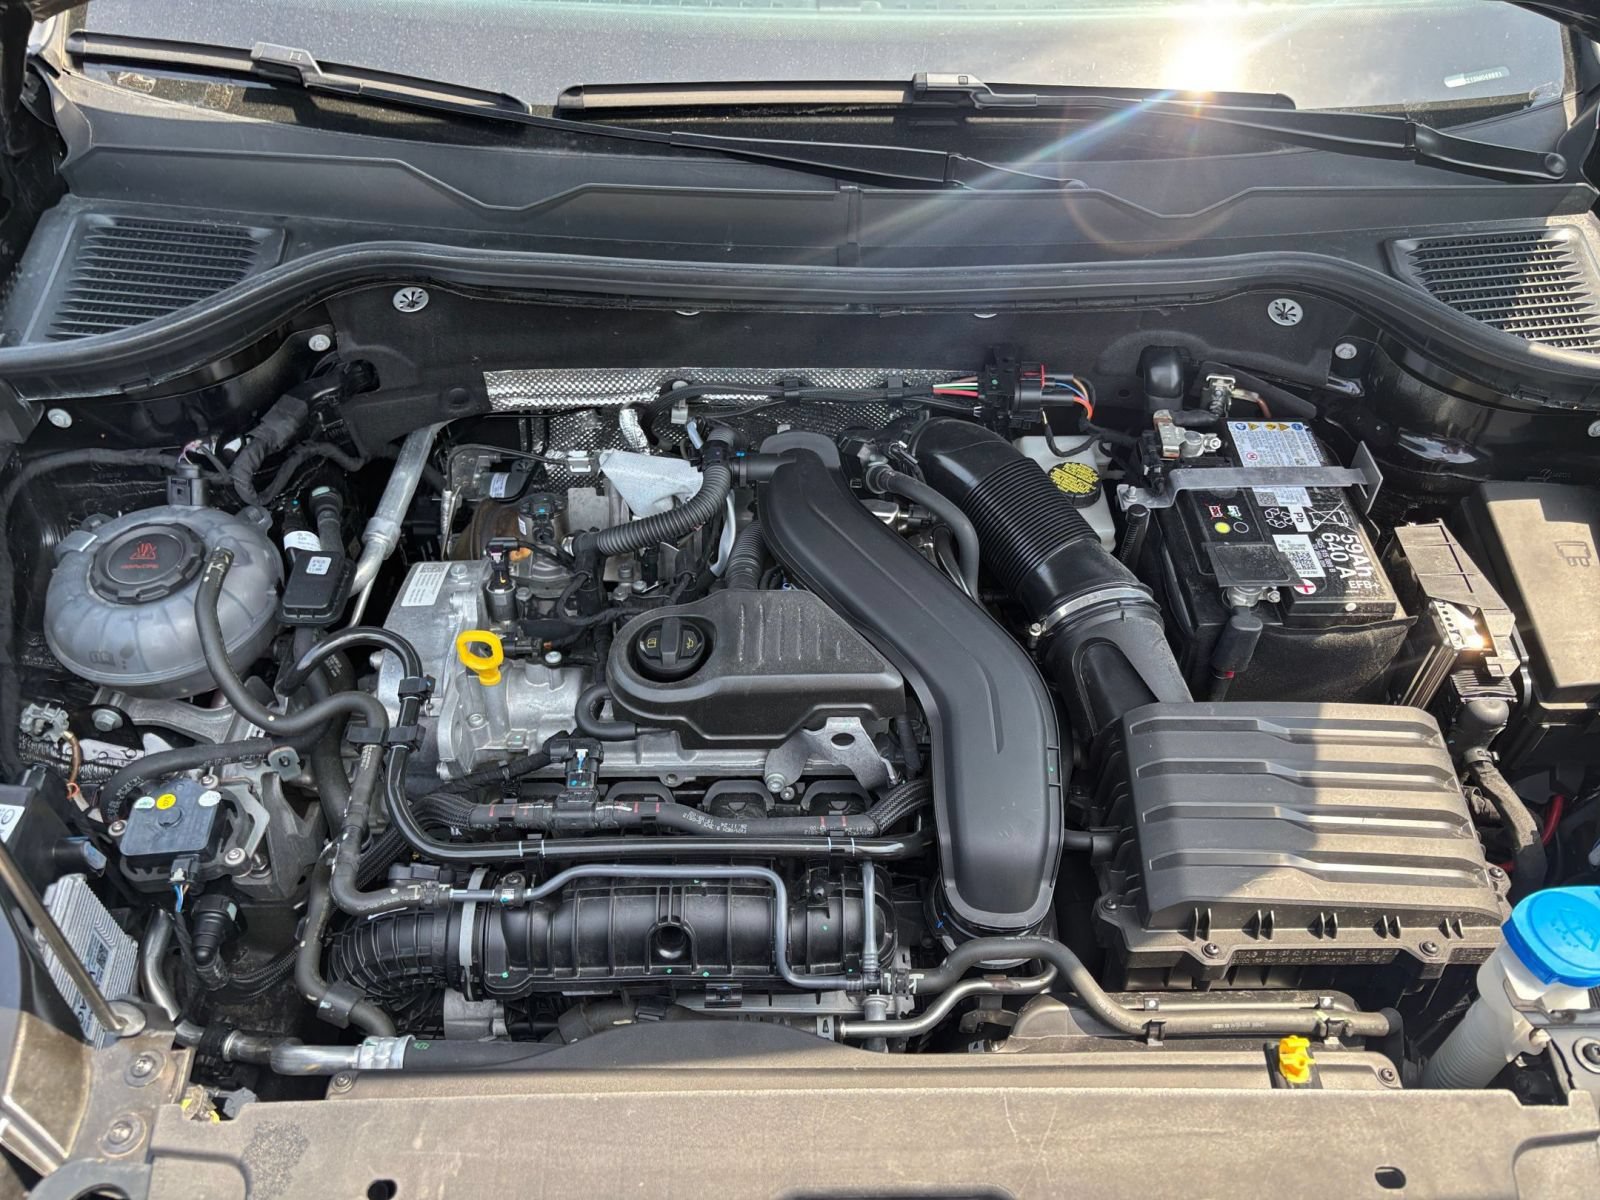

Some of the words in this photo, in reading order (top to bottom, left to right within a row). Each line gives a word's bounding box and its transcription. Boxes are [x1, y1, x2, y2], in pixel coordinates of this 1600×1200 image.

[1294, 512, 1305, 523] Pb
[1321, 533, 1349, 562] 640
[1335, 566, 1356, 579] A
[1341, 534, 1374, 577] 59Ah
[1348, 580, 1381, 590] EFB+
